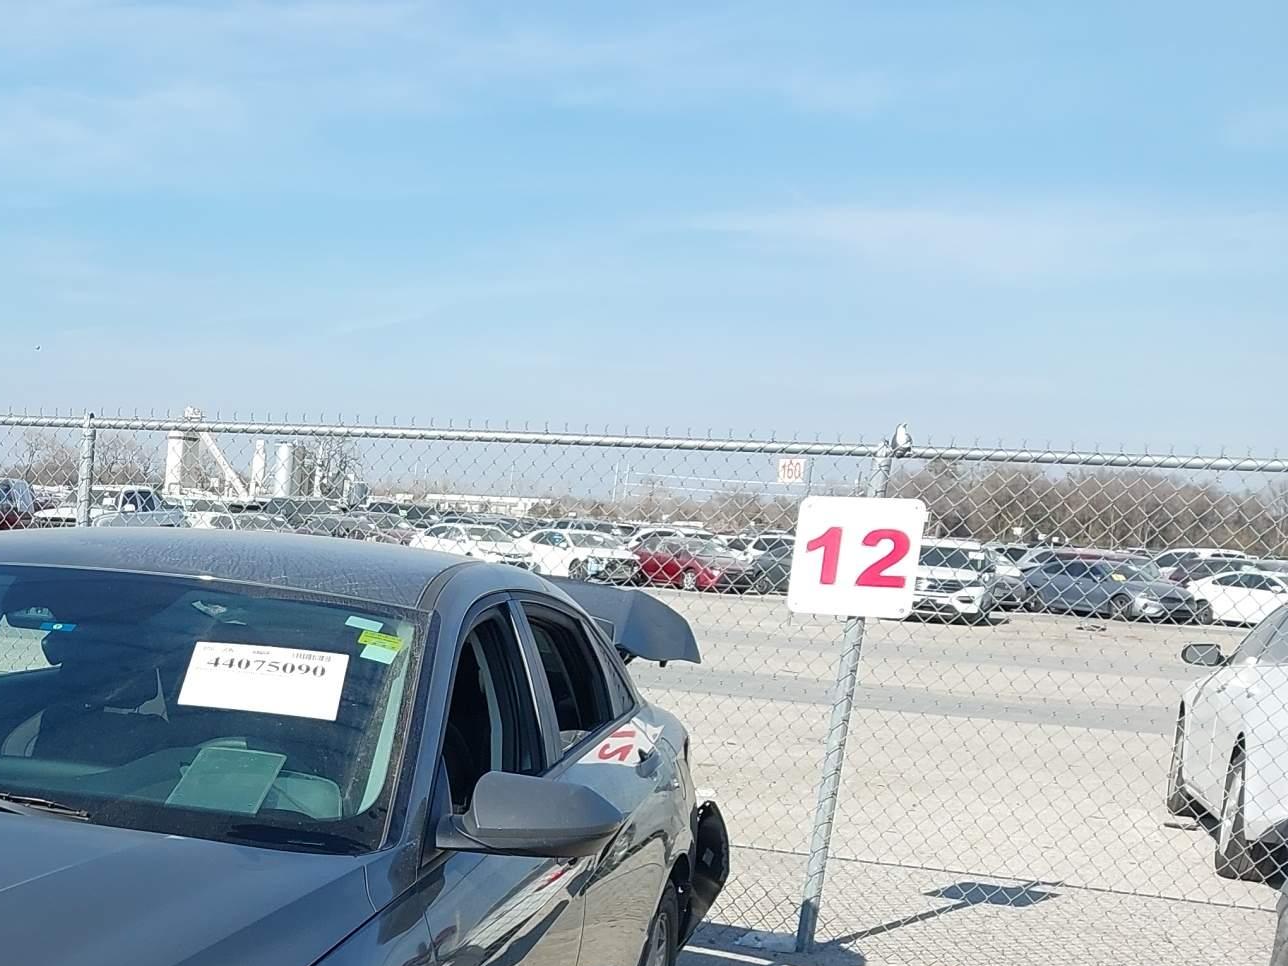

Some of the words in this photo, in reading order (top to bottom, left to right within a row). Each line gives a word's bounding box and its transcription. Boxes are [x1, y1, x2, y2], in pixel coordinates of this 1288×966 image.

[782, 460, 801, 479] 160
[806, 526, 910, 588] 12
[207, 656, 326, 677] 44075090
